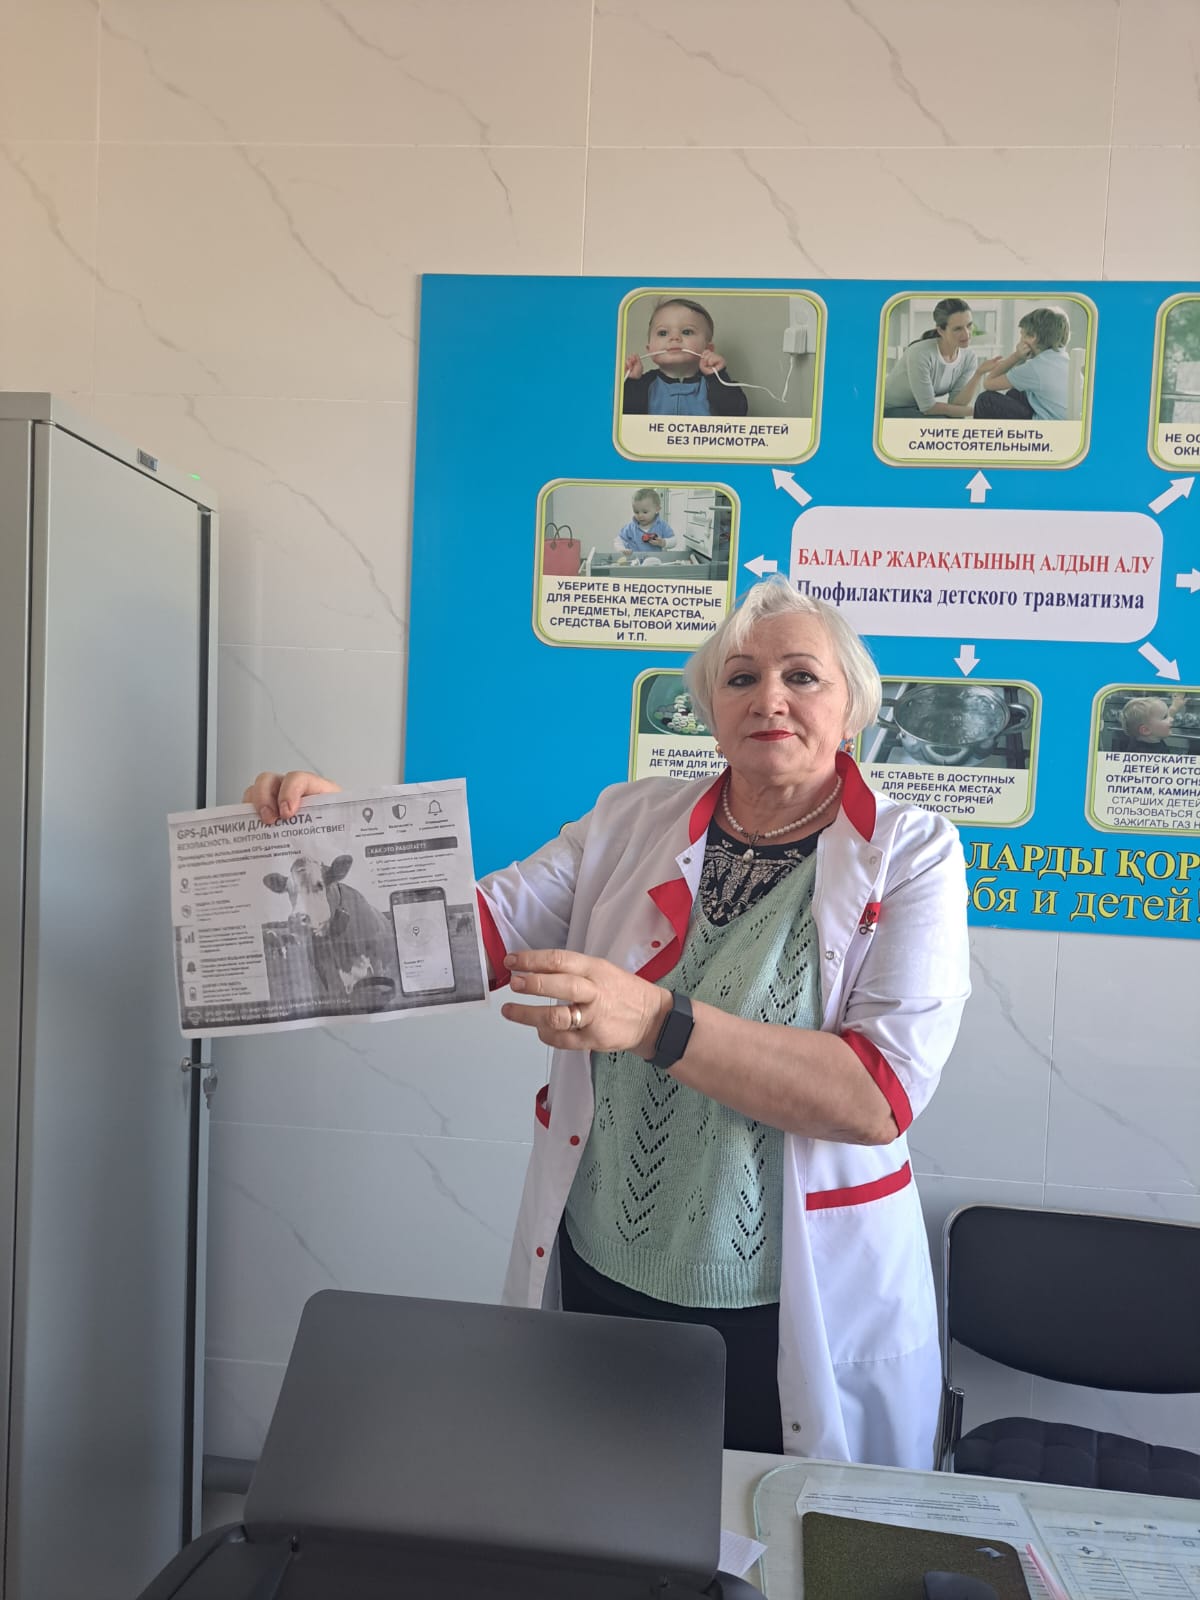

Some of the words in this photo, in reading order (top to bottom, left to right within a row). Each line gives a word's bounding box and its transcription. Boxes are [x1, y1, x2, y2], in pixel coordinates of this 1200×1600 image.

[648, 423, 664, 432] НЕ
[668, 422, 746, 434] ОСТАВЛЯЙТЕ
[749, 424, 789, 435] ДЕТЕЙ
[920, 428, 959, 438] УЧИТЕ
[962, 428, 1004, 439] ДЕТЕЙ
[1007, 430, 1043, 439] БЫТЬ
[667, 436, 689, 445] БЕЗ
[693, 436, 769, 447] ПРИСМОТРА.
[1165, 433, 1182, 443] НЕ
[908, 441, 1053, 452] САМОСТОЯТЕЛЬНЫМИ.
[798, 548, 883, 567] БАЛАЛАР
[886, 550, 1035, 574] ЖАРАҚАТЫНЫҢ
[1040, 554, 1109, 575] АЛДЫН
[1114, 555, 1155, 574] АЛУ
[557, 581, 608, 592] УБЕРИТЕ
[613, 583, 620, 592] В
[624, 583, 712, 595] НЕДОСТУПНЫЕ
[547, 593, 570, 604] ДЛЯ
[574, 594, 626, 604] РЕБЕНКА
[630, 596, 669, 606] МЕСТА
[673, 598, 722, 608] ОСТРЫЕ
[797, 580, 932, 607] Профилактика
[937, 587, 1018, 607] детского
[1023, 590, 1144, 611] травматизма
[562, 606, 630, 618] ПРЕДМЕТЫ,
[634, 608, 704, 620] ЛЕКАРСТВА,
[550, 617, 610, 629] СРЕДСТВА
[614, 618, 672, 630] БЫТОВОЙ
[617, 632, 624, 640] И
[628, 632, 647, 641] Т.П.
[652, 748, 665, 756] НЕ
[668, 748, 714, 758] ДАВАЙТЕ
[1106, 753, 1120, 761] НЕ
[650, 758, 684, 768] ДЕТЯМ
[686, 760, 707, 769] ДЛЯ
[1123, 764, 1159, 774] ДЕТЕЙ
[871, 770, 884, 778] НЕ
[887, 771, 934, 781] СТАВЬТЕ
[937, 773, 945, 781] В
[947, 774, 1015, 784] ДОСТУПНЫХ
[1106, 774, 1173, 785] ОТКРЫТОГО
[882, 781, 904, 790] ДЛЯ
[907, 782, 956, 792] РЕБЕНКА
[959, 785, 1001, 794] МЕСТАХ
[1107, 785, 1155, 796] ПЛИТАМ,
[889, 792, 931, 802] ПОСУДУ
[934, 794, 941, 802] С
[944, 794, 993, 805] ГОРЯЧЕЙ
[1112, 796, 1163, 806] СТАРШИХ
[1107, 807, 1192, 818] ПОЛЬЗОВАТЬСЯ
[176, 821, 246, 840] GPS-ДАТЧИКИ
[274, 812, 313, 827] СКОТА
[1114, 817, 1169, 828] ЗАЖИГАТЬ
[1173, 820, 1190, 829] ГАЗ
[273, 831, 279, 839] И
[281, 824, 345, 837] СПОКОЙСТВИЕ!
[966, 842, 1107, 881] ЛАРДЫ
[968, 875, 1018, 913] бя
[1031, 888, 1058, 915] и
